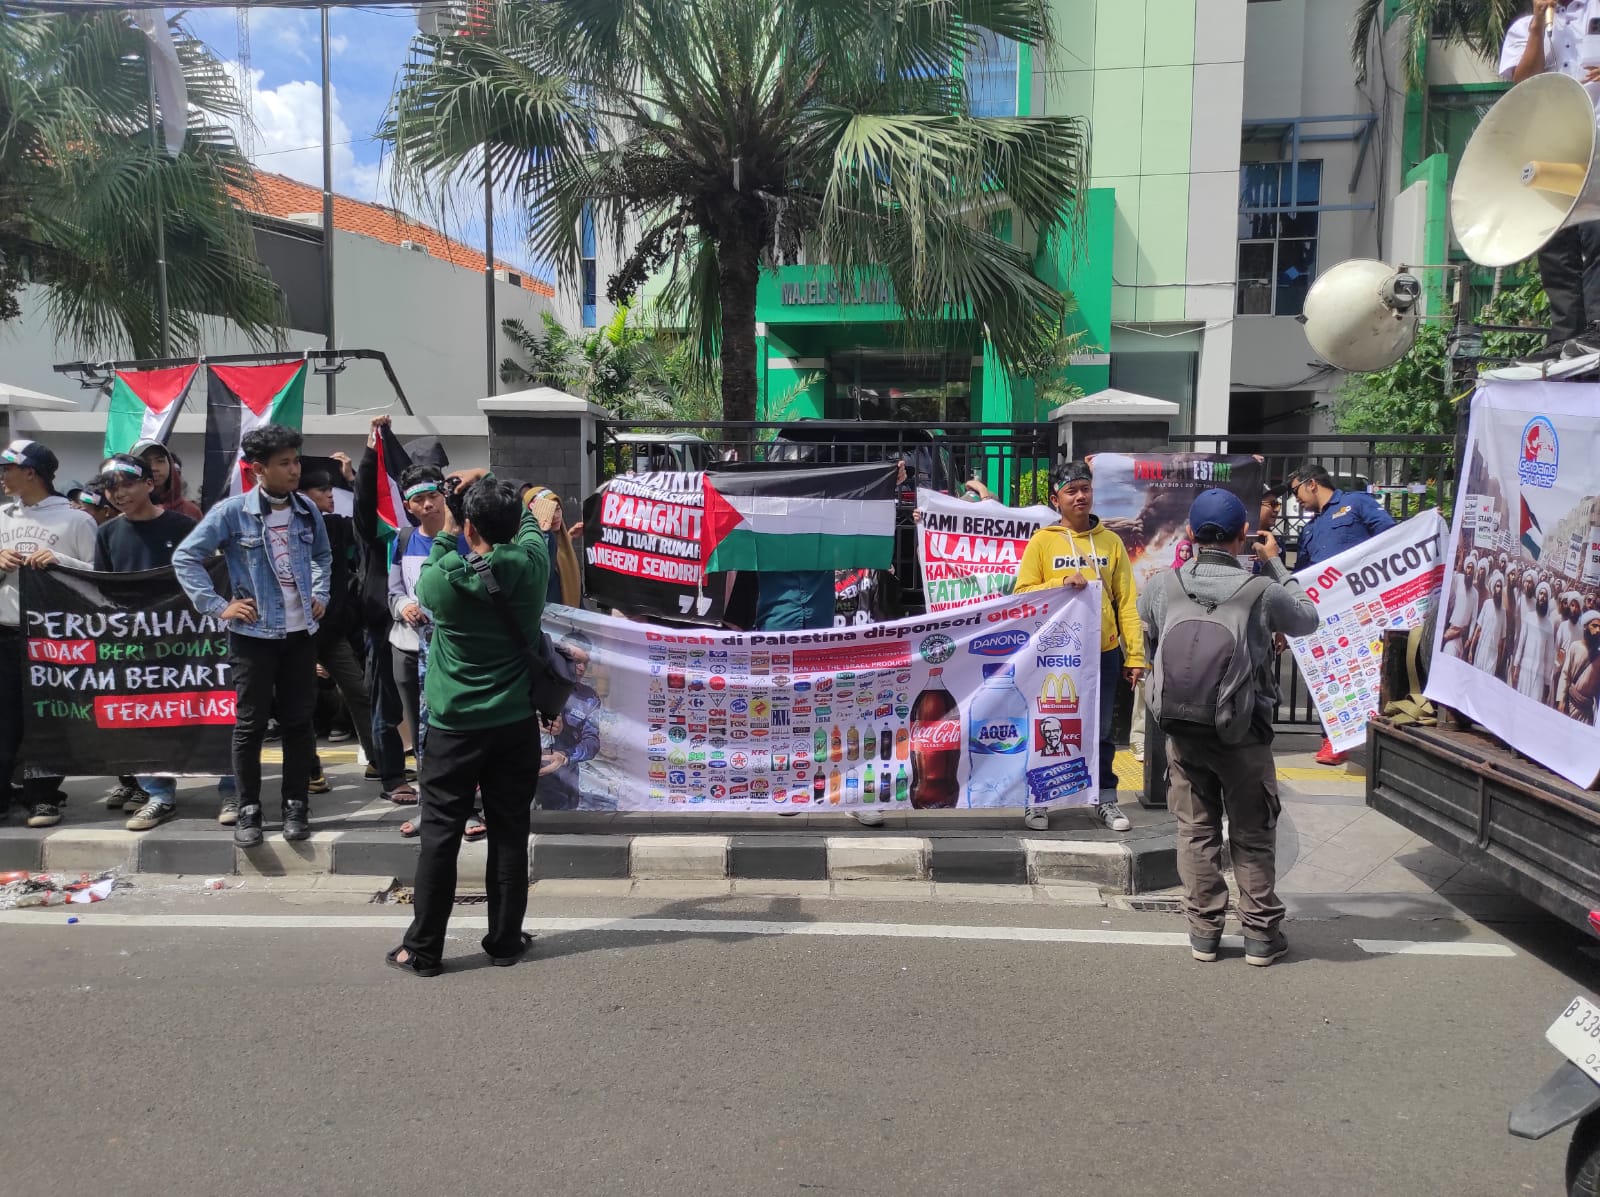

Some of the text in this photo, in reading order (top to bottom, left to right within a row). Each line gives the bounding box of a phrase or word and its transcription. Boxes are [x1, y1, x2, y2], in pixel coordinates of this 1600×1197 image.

[781, 281, 837, 305] MAJELIS
[615, 471, 704, 492] AATNY
[1134, 461, 1164, 480] FREE
[608, 481, 650, 498] PRODUK
[603, 493, 704, 539] BANGKIT
[963, 516, 1041, 540] BERSAMA
[1, 526, 60, 546] DICKIES
[602, 527, 624, 546] JADI
[627, 532, 657, 552] TUAN
[597, 547, 639, 573] NEGERI
[641, 556, 700, 583] SENDIRI
[1317, 566, 1344, 590] on
[1345, 533, 1441, 597] BOYCOTT
[927, 574, 982, 604] FATWA
[646, 632, 715, 646] Darah
[722, 634, 743, 646] di
[750, 631, 857, 646] Palestina
[863, 612, 982, 640] disponsori
[987, 603, 1037, 623] oleh
[30, 665, 116, 691] BUKAN
[979, 724, 1019, 741] AQUA
[1062, 733, 1081, 741] KFC
[1050, 782, 1077, 798] OREO
[1563, 1000, 1581, 1018] B
